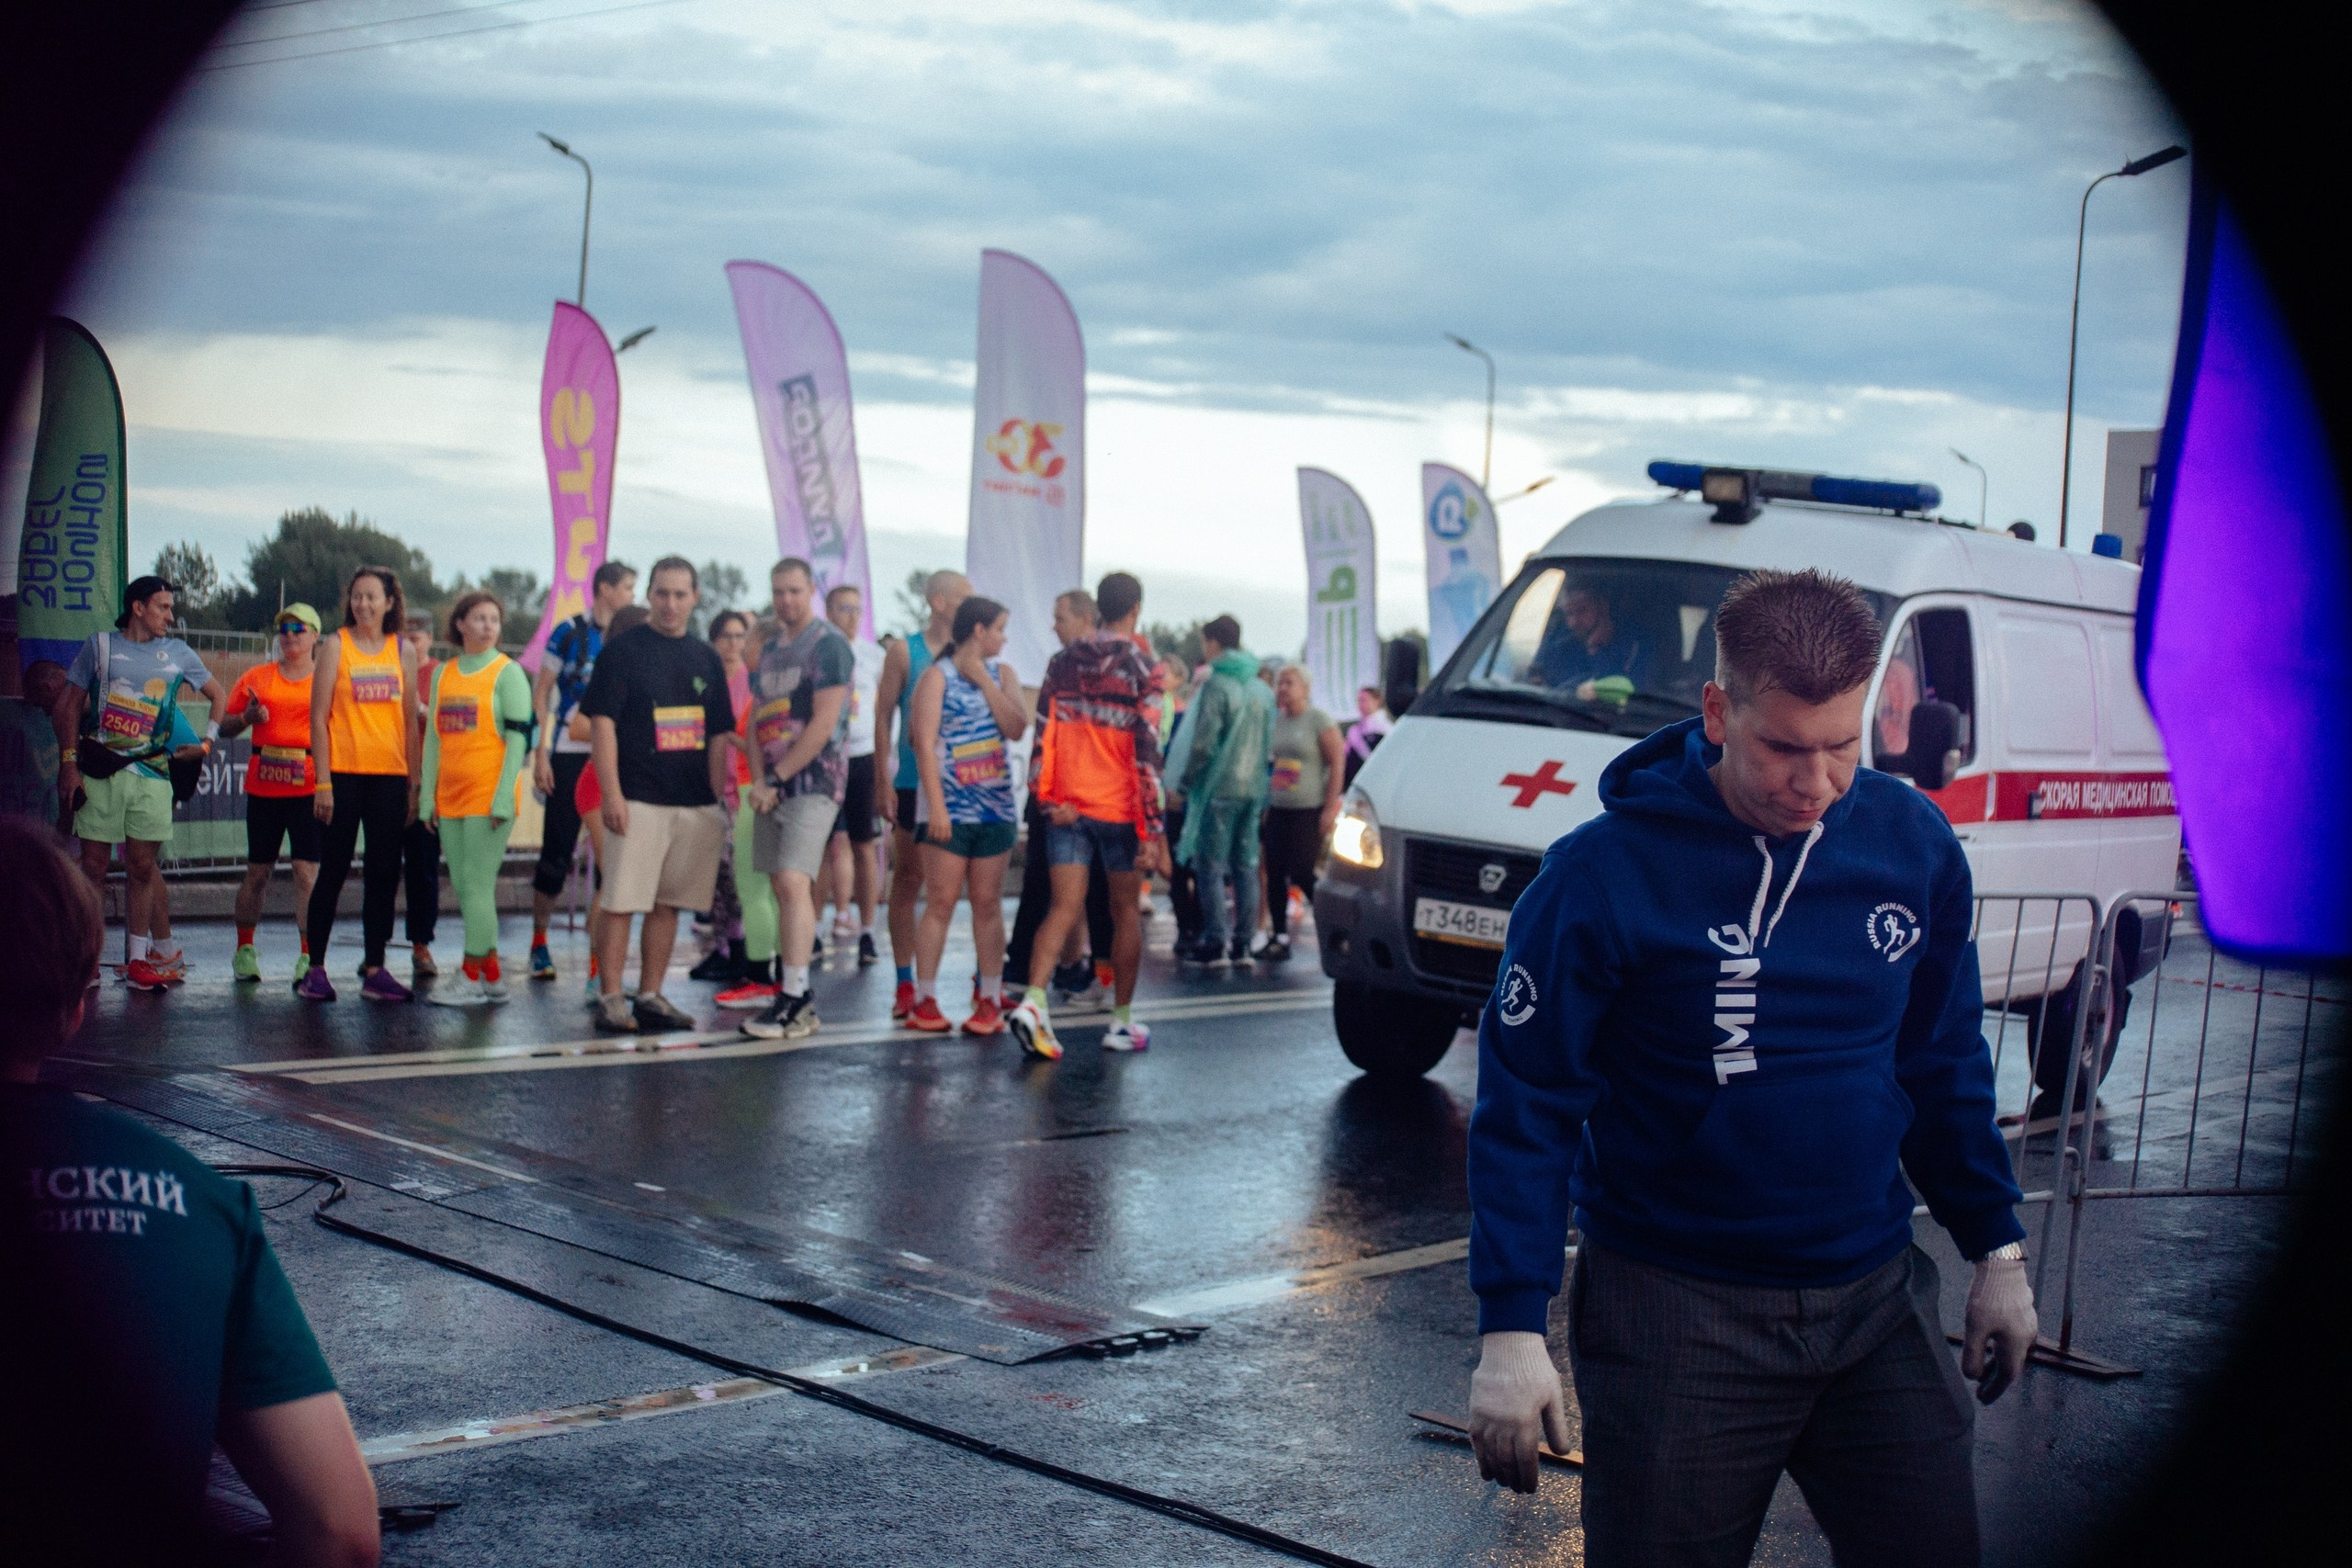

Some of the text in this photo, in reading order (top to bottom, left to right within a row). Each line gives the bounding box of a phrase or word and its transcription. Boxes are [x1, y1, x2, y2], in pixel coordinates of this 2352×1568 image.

[356, 683, 390, 701] 2377
[104, 713, 140, 735] 2540
[2038, 781, 2176, 814] СКОРАЯ МЕДИЦИНСКАЯ ПОМО
[1874, 902, 1917, 924] RUNNING
[1867, 913, 1882, 950] RUSSIA
[1513, 964, 1538, 1002] RUNNING
[1707, 923, 1761, 1086] TIMING
